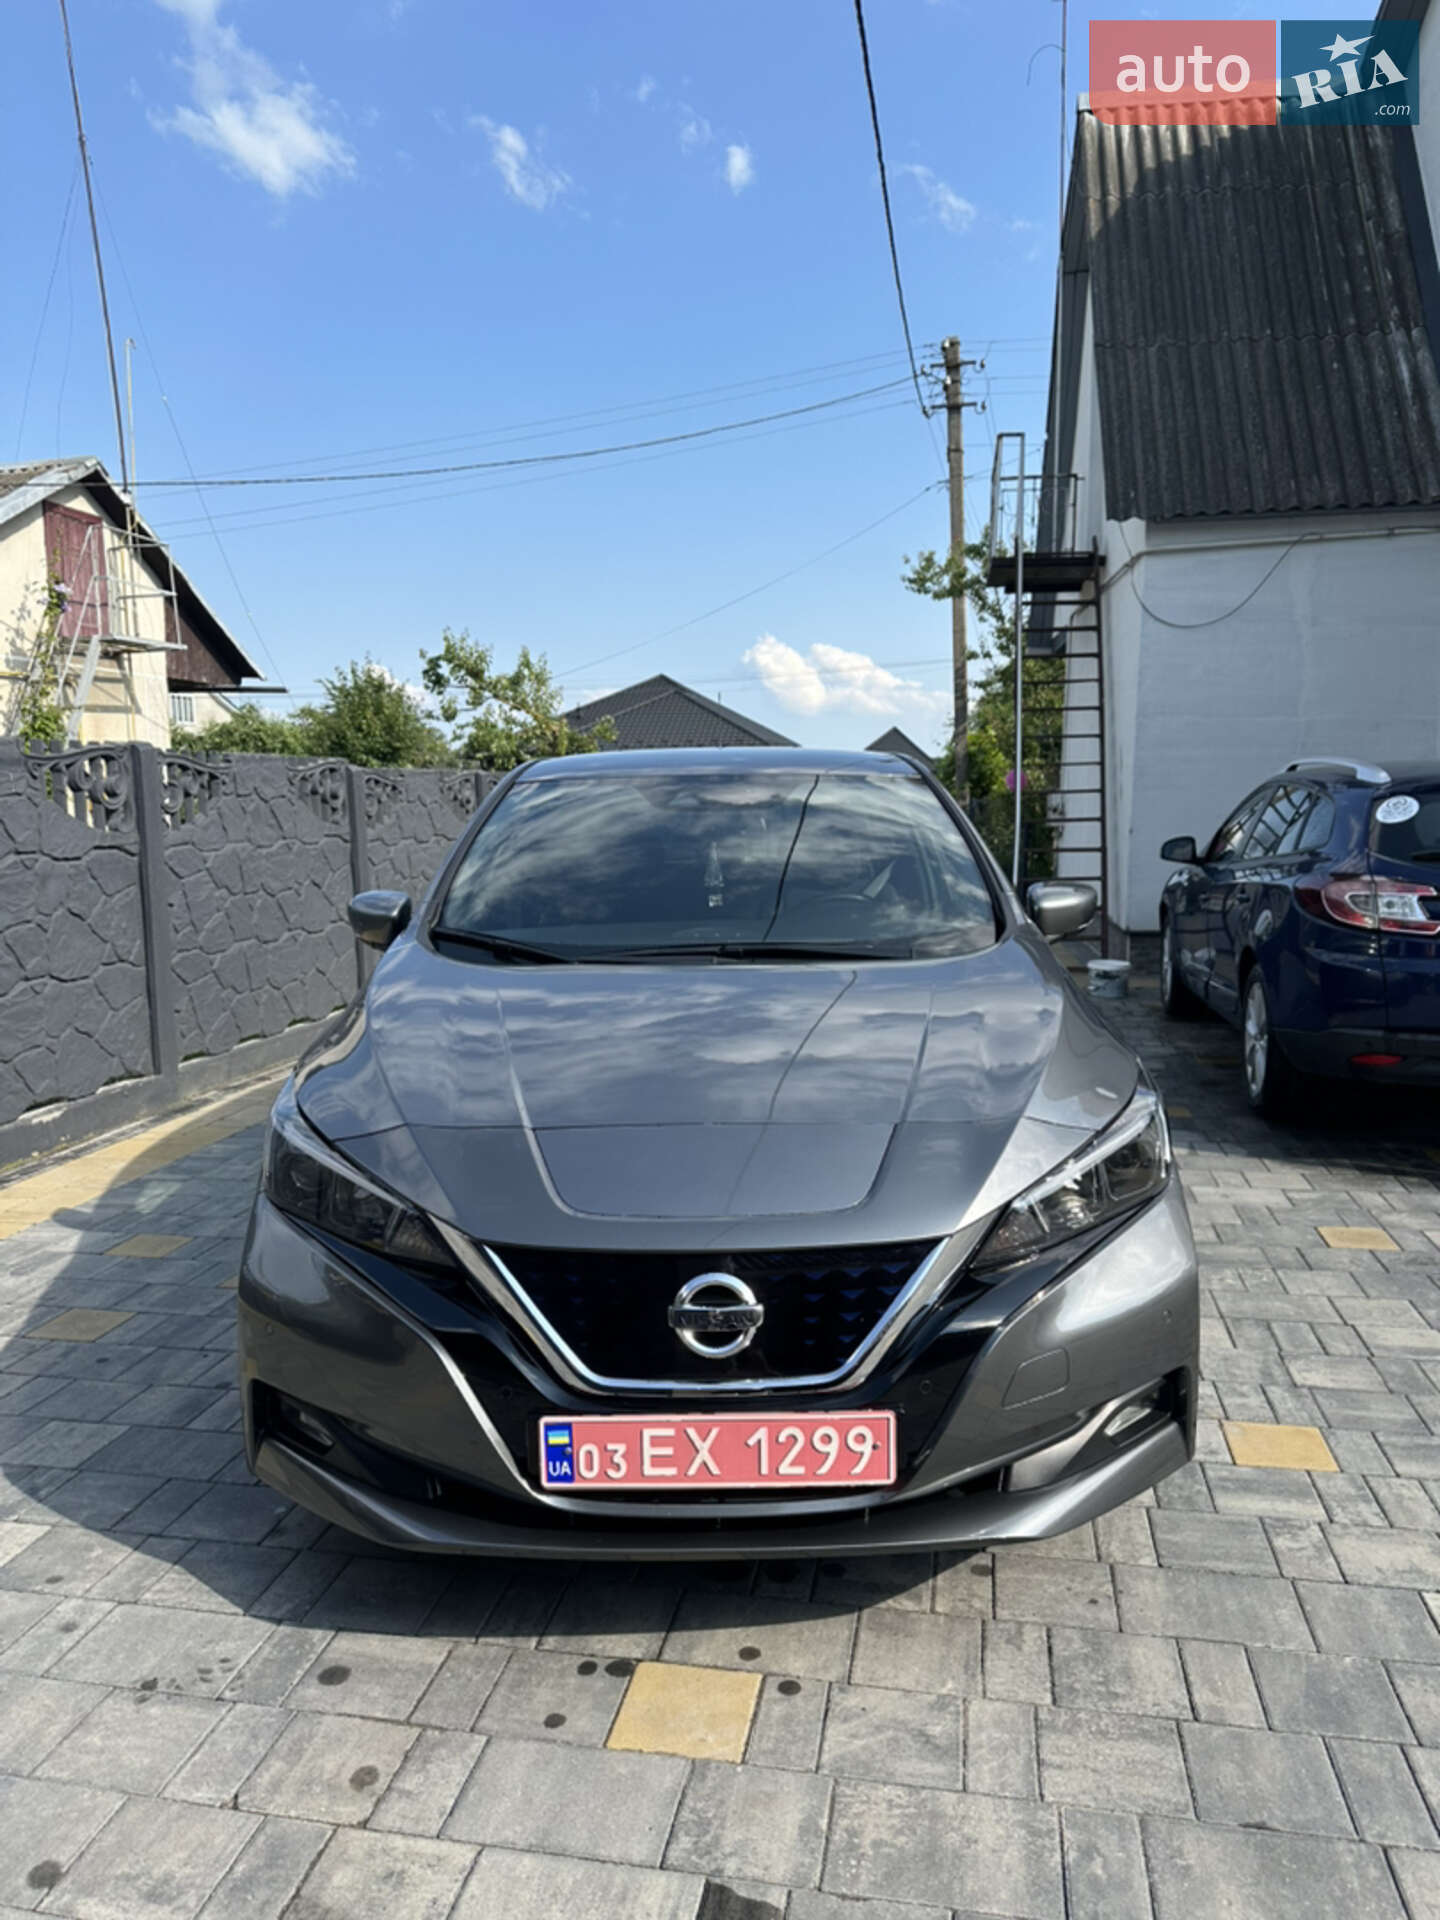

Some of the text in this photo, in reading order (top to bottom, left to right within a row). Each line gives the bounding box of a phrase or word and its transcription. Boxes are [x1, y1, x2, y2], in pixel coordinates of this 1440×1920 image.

[548, 1461, 572, 1477] UA
[578, 1425, 874, 1479] 03 EX 1299
